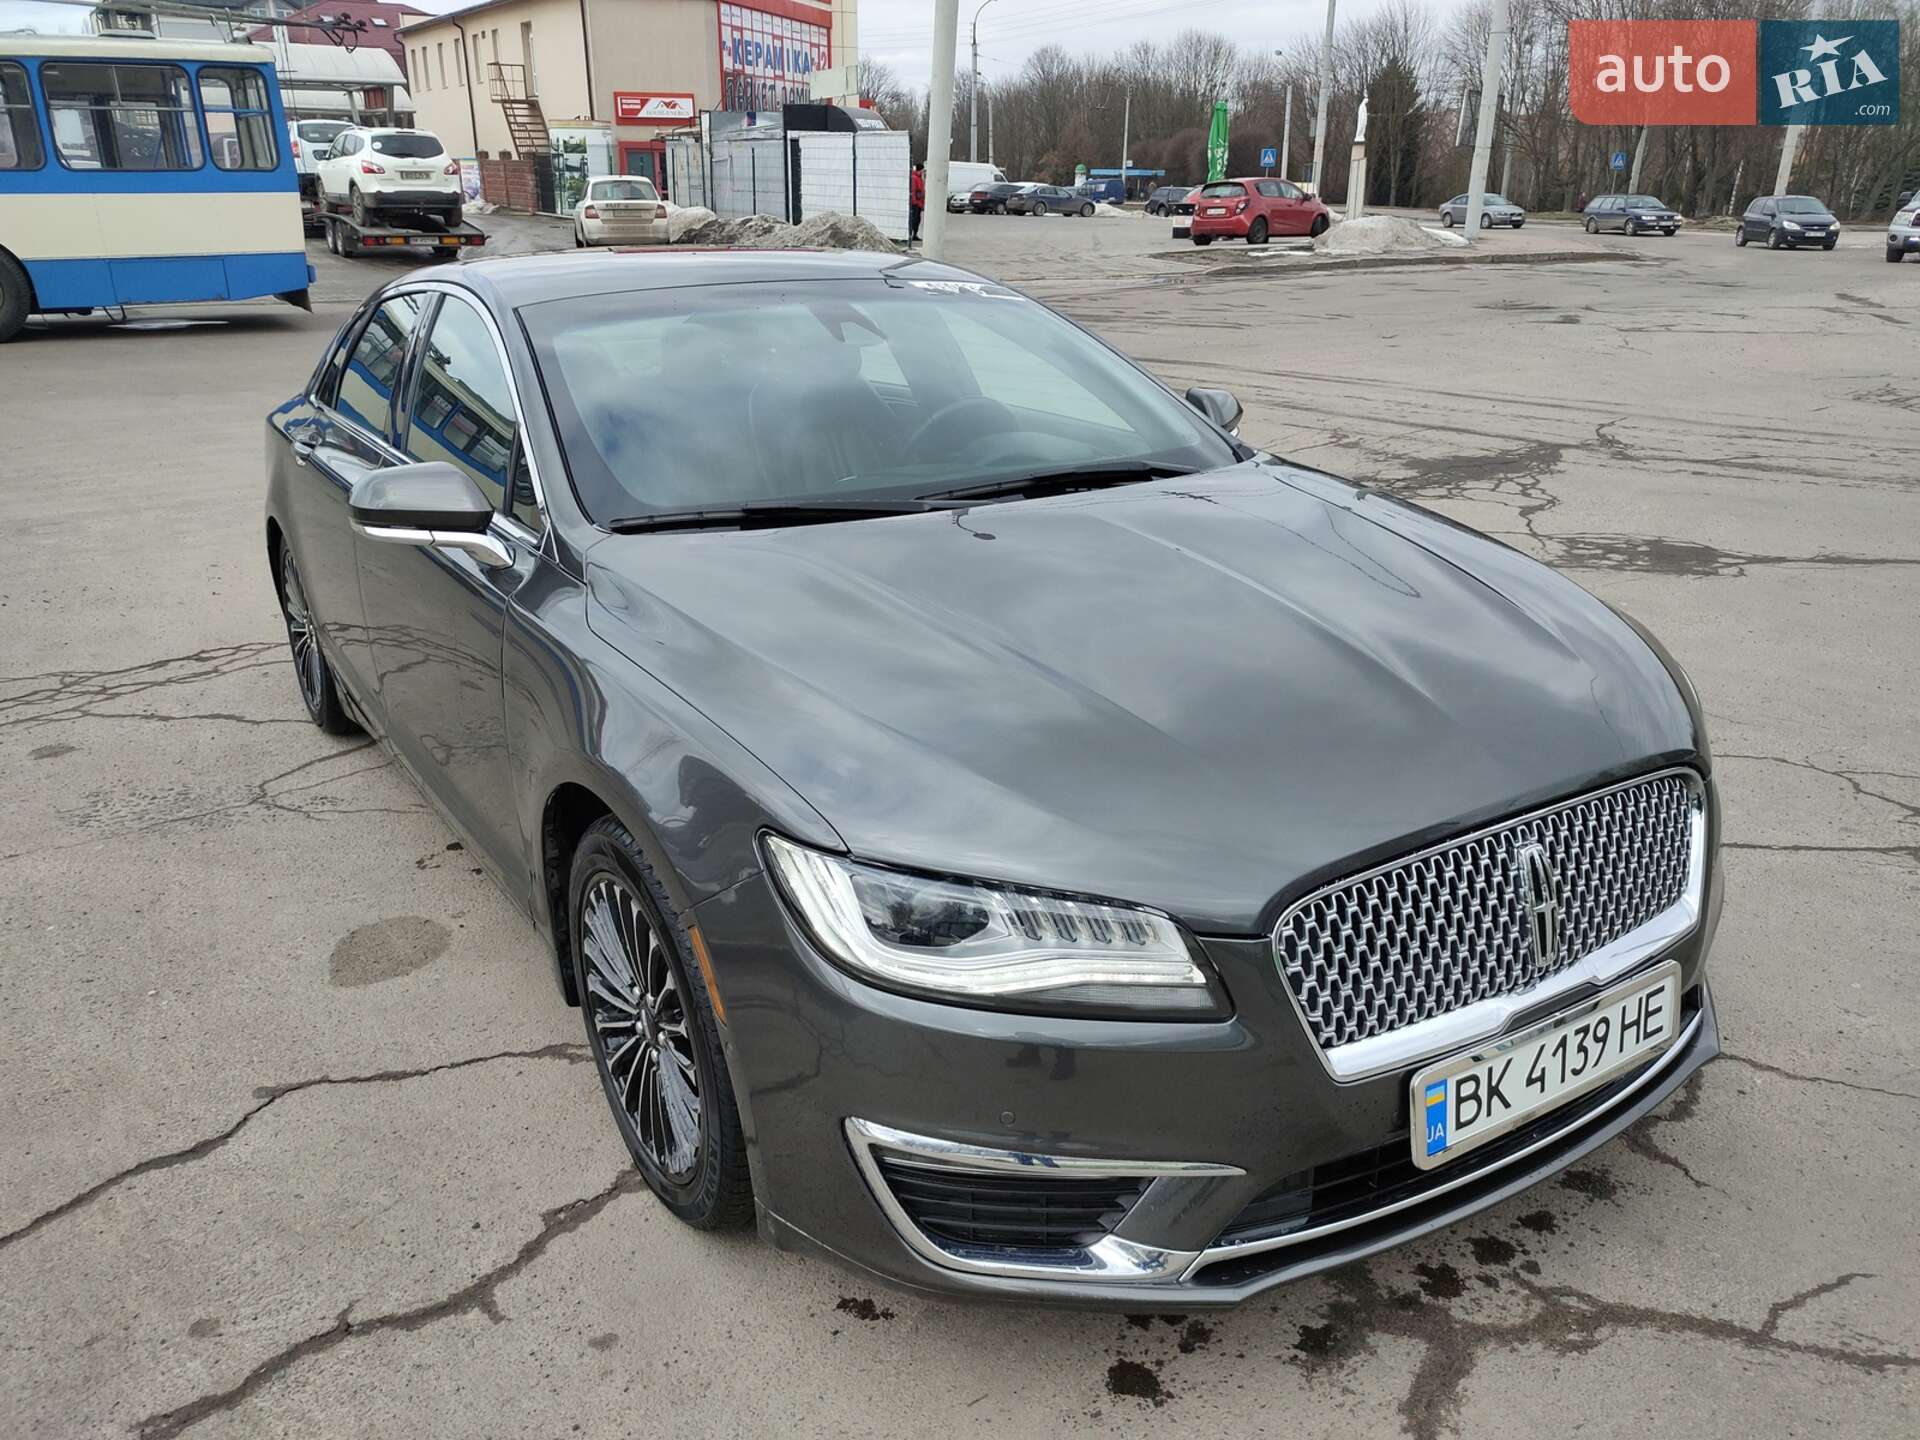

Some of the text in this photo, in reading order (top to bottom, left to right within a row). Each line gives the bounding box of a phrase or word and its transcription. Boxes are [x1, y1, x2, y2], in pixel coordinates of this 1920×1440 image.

[733, 37, 811, 75] КЕРАМІКА
[1454, 985, 1665, 1130] BK 4139 HE
[1426, 1122, 1445, 1143] UA
